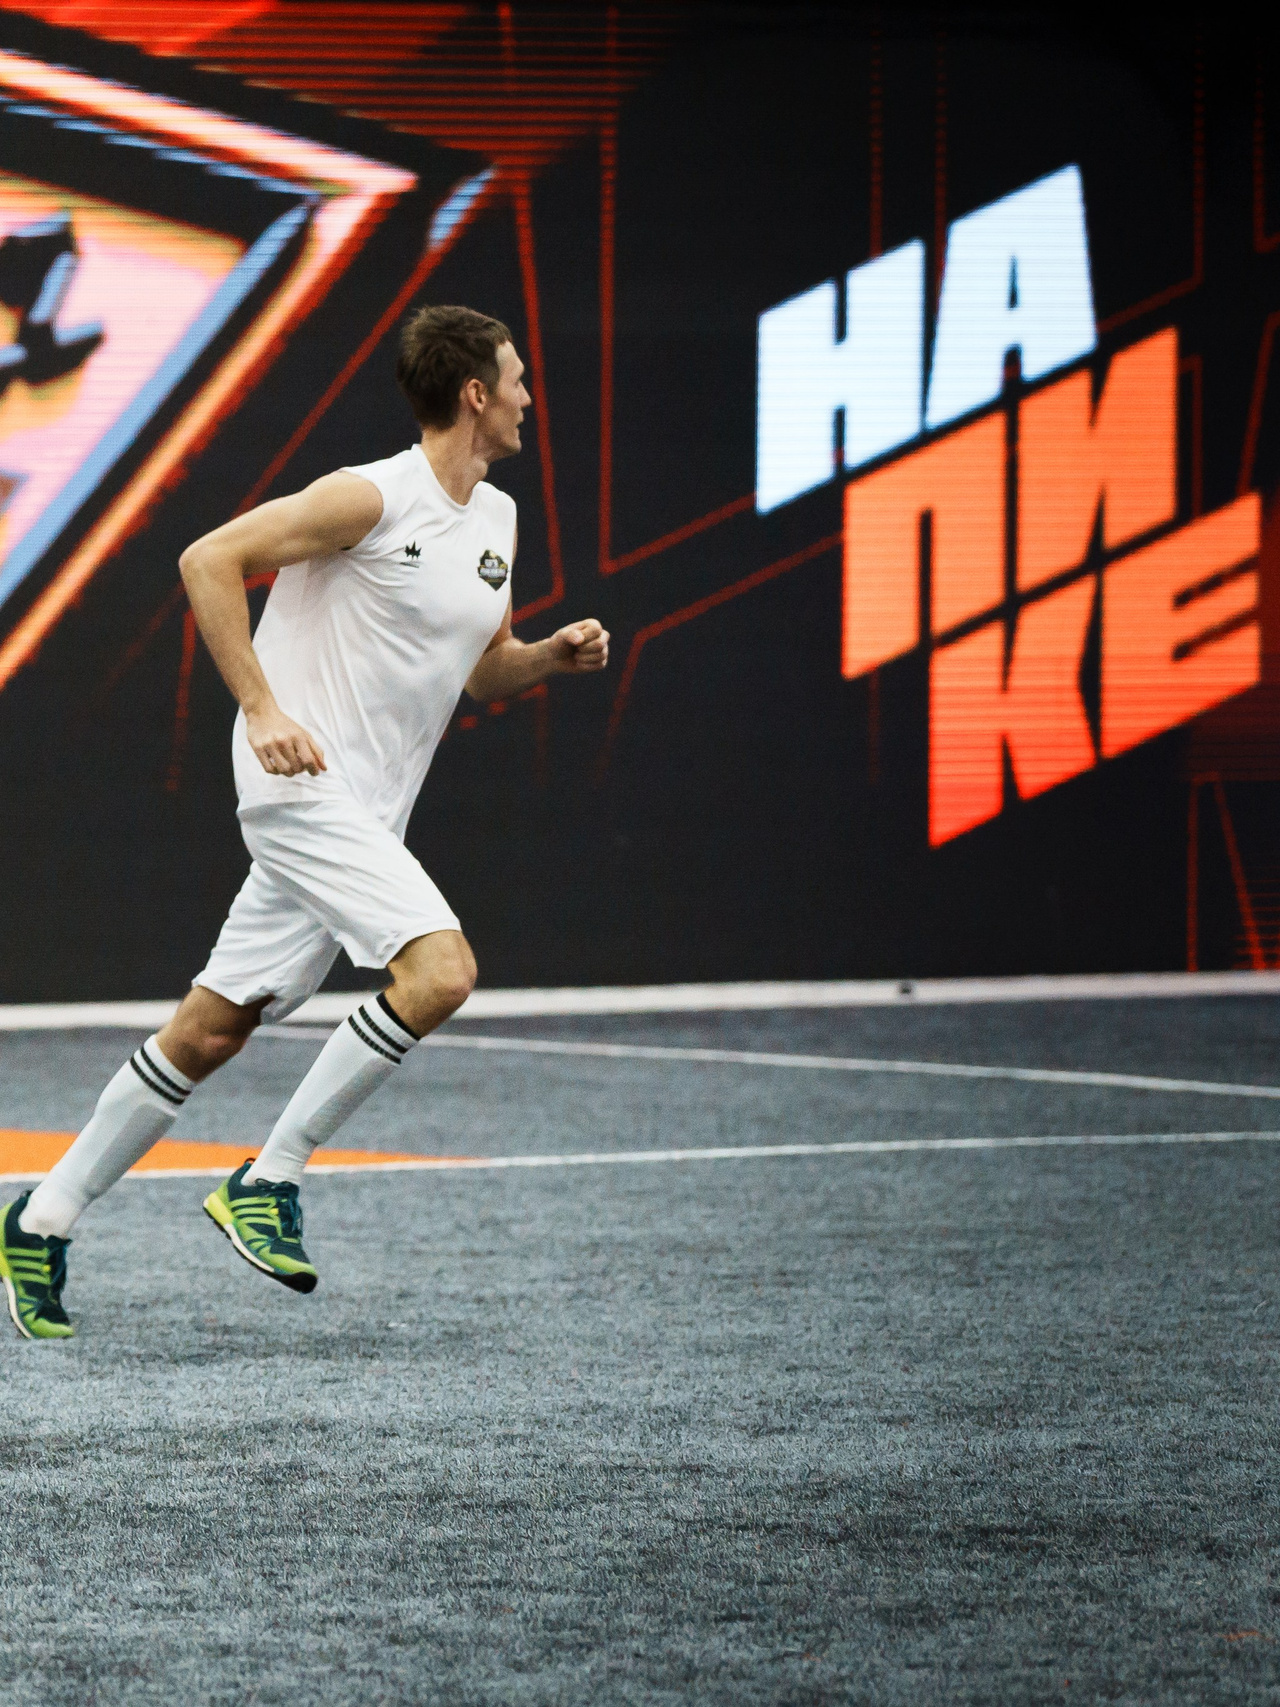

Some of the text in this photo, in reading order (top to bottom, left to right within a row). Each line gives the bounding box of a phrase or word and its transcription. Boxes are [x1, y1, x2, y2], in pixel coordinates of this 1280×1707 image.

[755, 163, 1098, 516] НА
[841, 325, 1180, 681] ПИ
[928, 490, 1262, 849] КЕ
